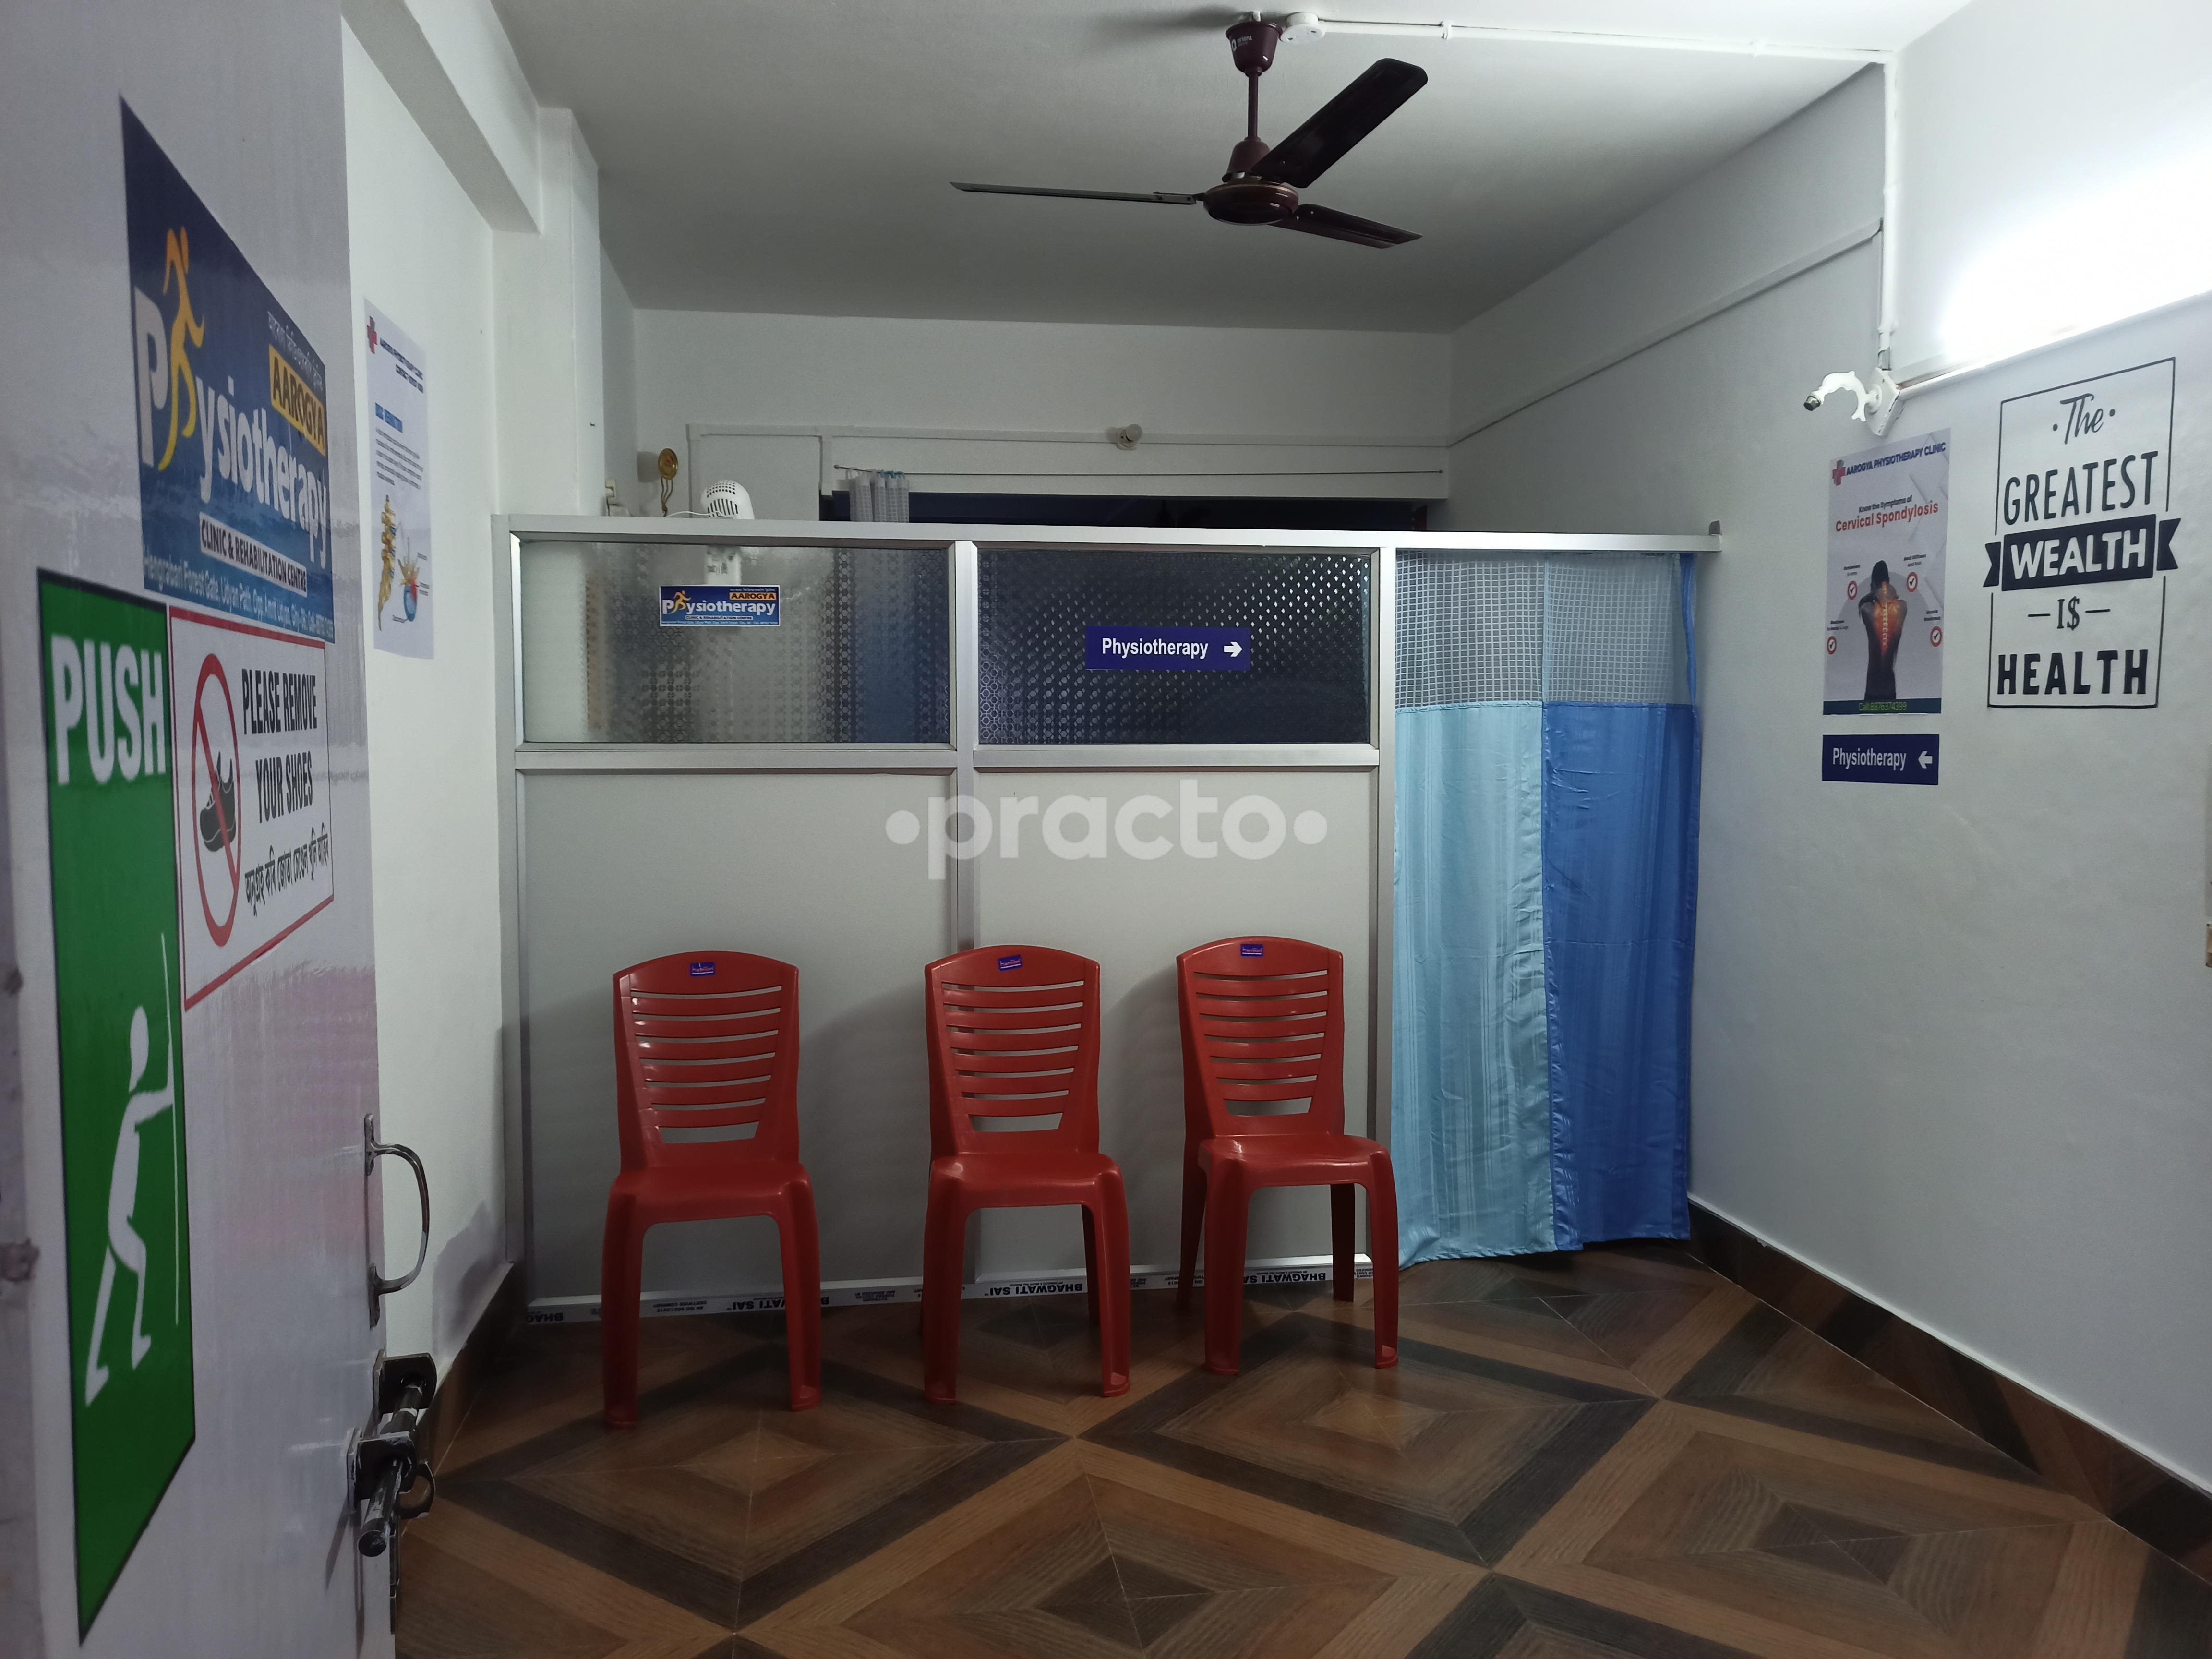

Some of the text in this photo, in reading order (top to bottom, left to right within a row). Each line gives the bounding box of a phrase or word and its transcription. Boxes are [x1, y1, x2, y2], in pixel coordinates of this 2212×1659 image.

[273, 356, 325, 450] AAROGYA
[2060, 393, 2104, 445] The
[1846, 442, 1947, 475] AAROGYA PHYSIOTHERAPY CLINIC
[2004, 450, 2158, 526] GREATEST
[1836, 500, 1939, 532] Cervical Spondylosis
[201, 519, 306, 593] CLINIC & REHABILITATION CENTRE
[2010, 528, 2147, 580] WEALTH
[1102, 637, 1209, 660] Physiotherapy
[1997, 649, 2149, 695] HEALTH
[51, 633, 167, 786] PUSH
[242, 668, 317, 735] PLEASE REMOVE
[1832, 747, 1907, 771] Physiotherapy
[255, 750, 313, 824] YOUR SHOES
[989, 1287, 1011, 1296] SAI
[1015, 1283, 1083, 1295] BHAGWATI
[1262, 1273, 1326, 1283] BHAGWATI
[732, 1300, 755, 1310] SAI
